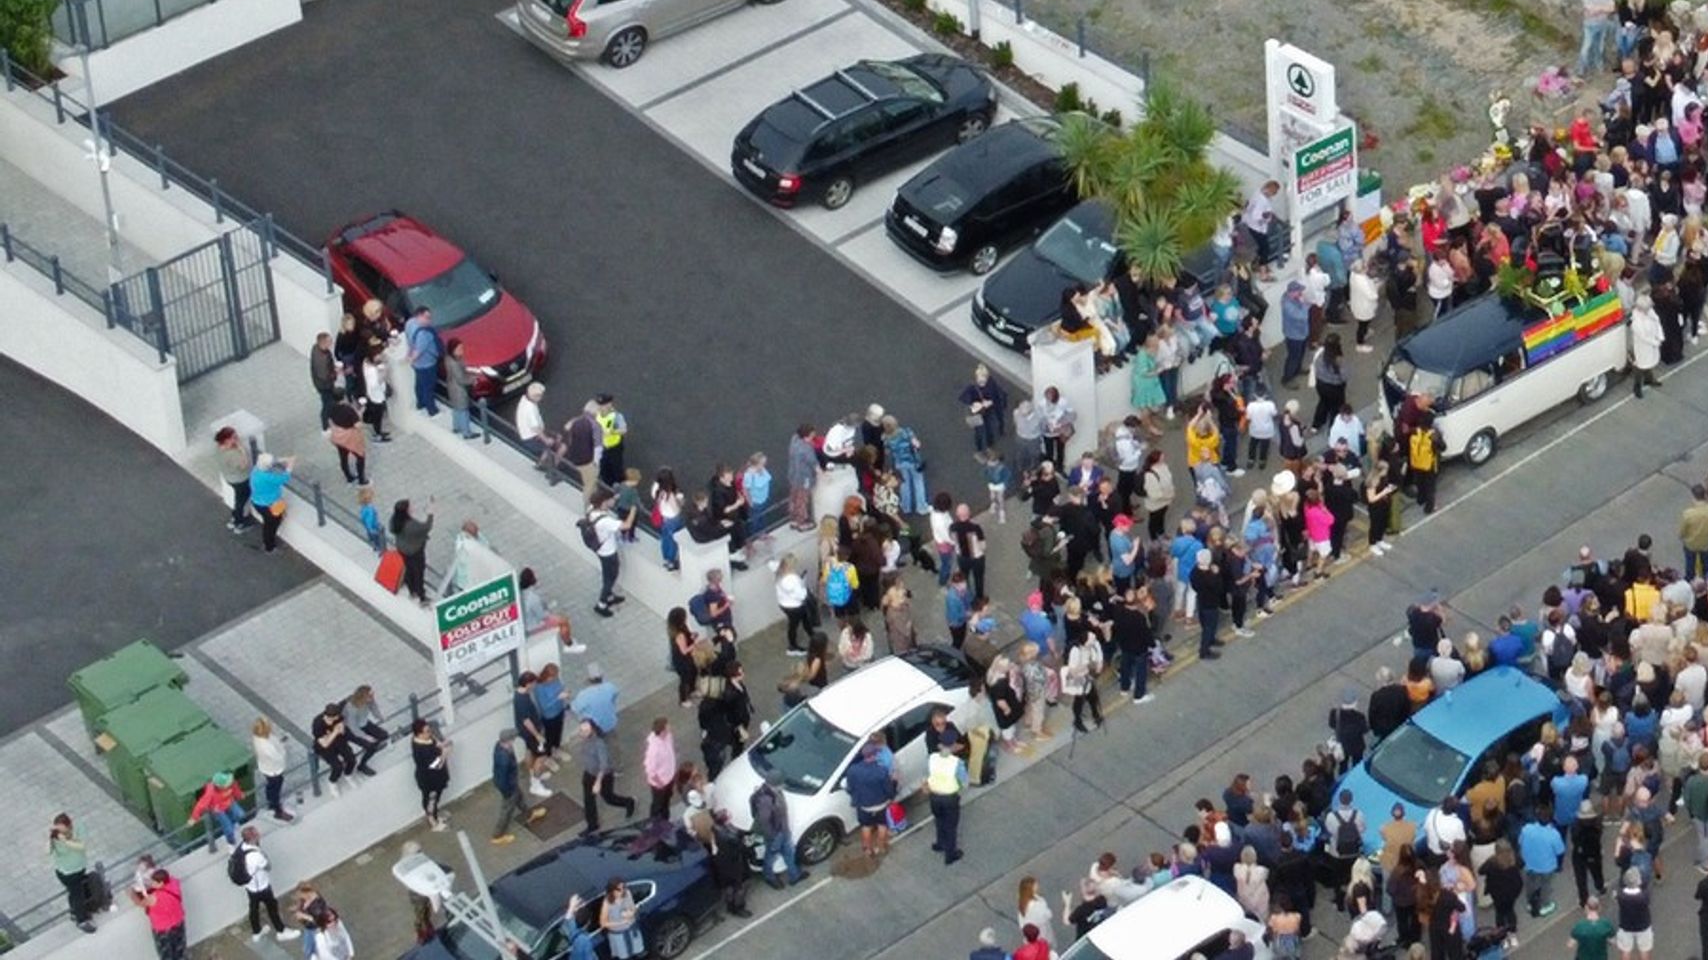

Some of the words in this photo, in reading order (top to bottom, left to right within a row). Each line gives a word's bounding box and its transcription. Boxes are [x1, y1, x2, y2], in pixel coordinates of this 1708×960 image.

[1301, 138, 1349, 167] Coonan
[1299, 188, 1322, 204] FOR
[1326, 174, 1351, 192] SALE
[445, 588, 508, 621] Coonan
[446, 621, 481, 641] SOLD
[483, 608, 511, 626] OUT
[447, 642, 477, 662] FOR
[483, 626, 516, 647] SALE
